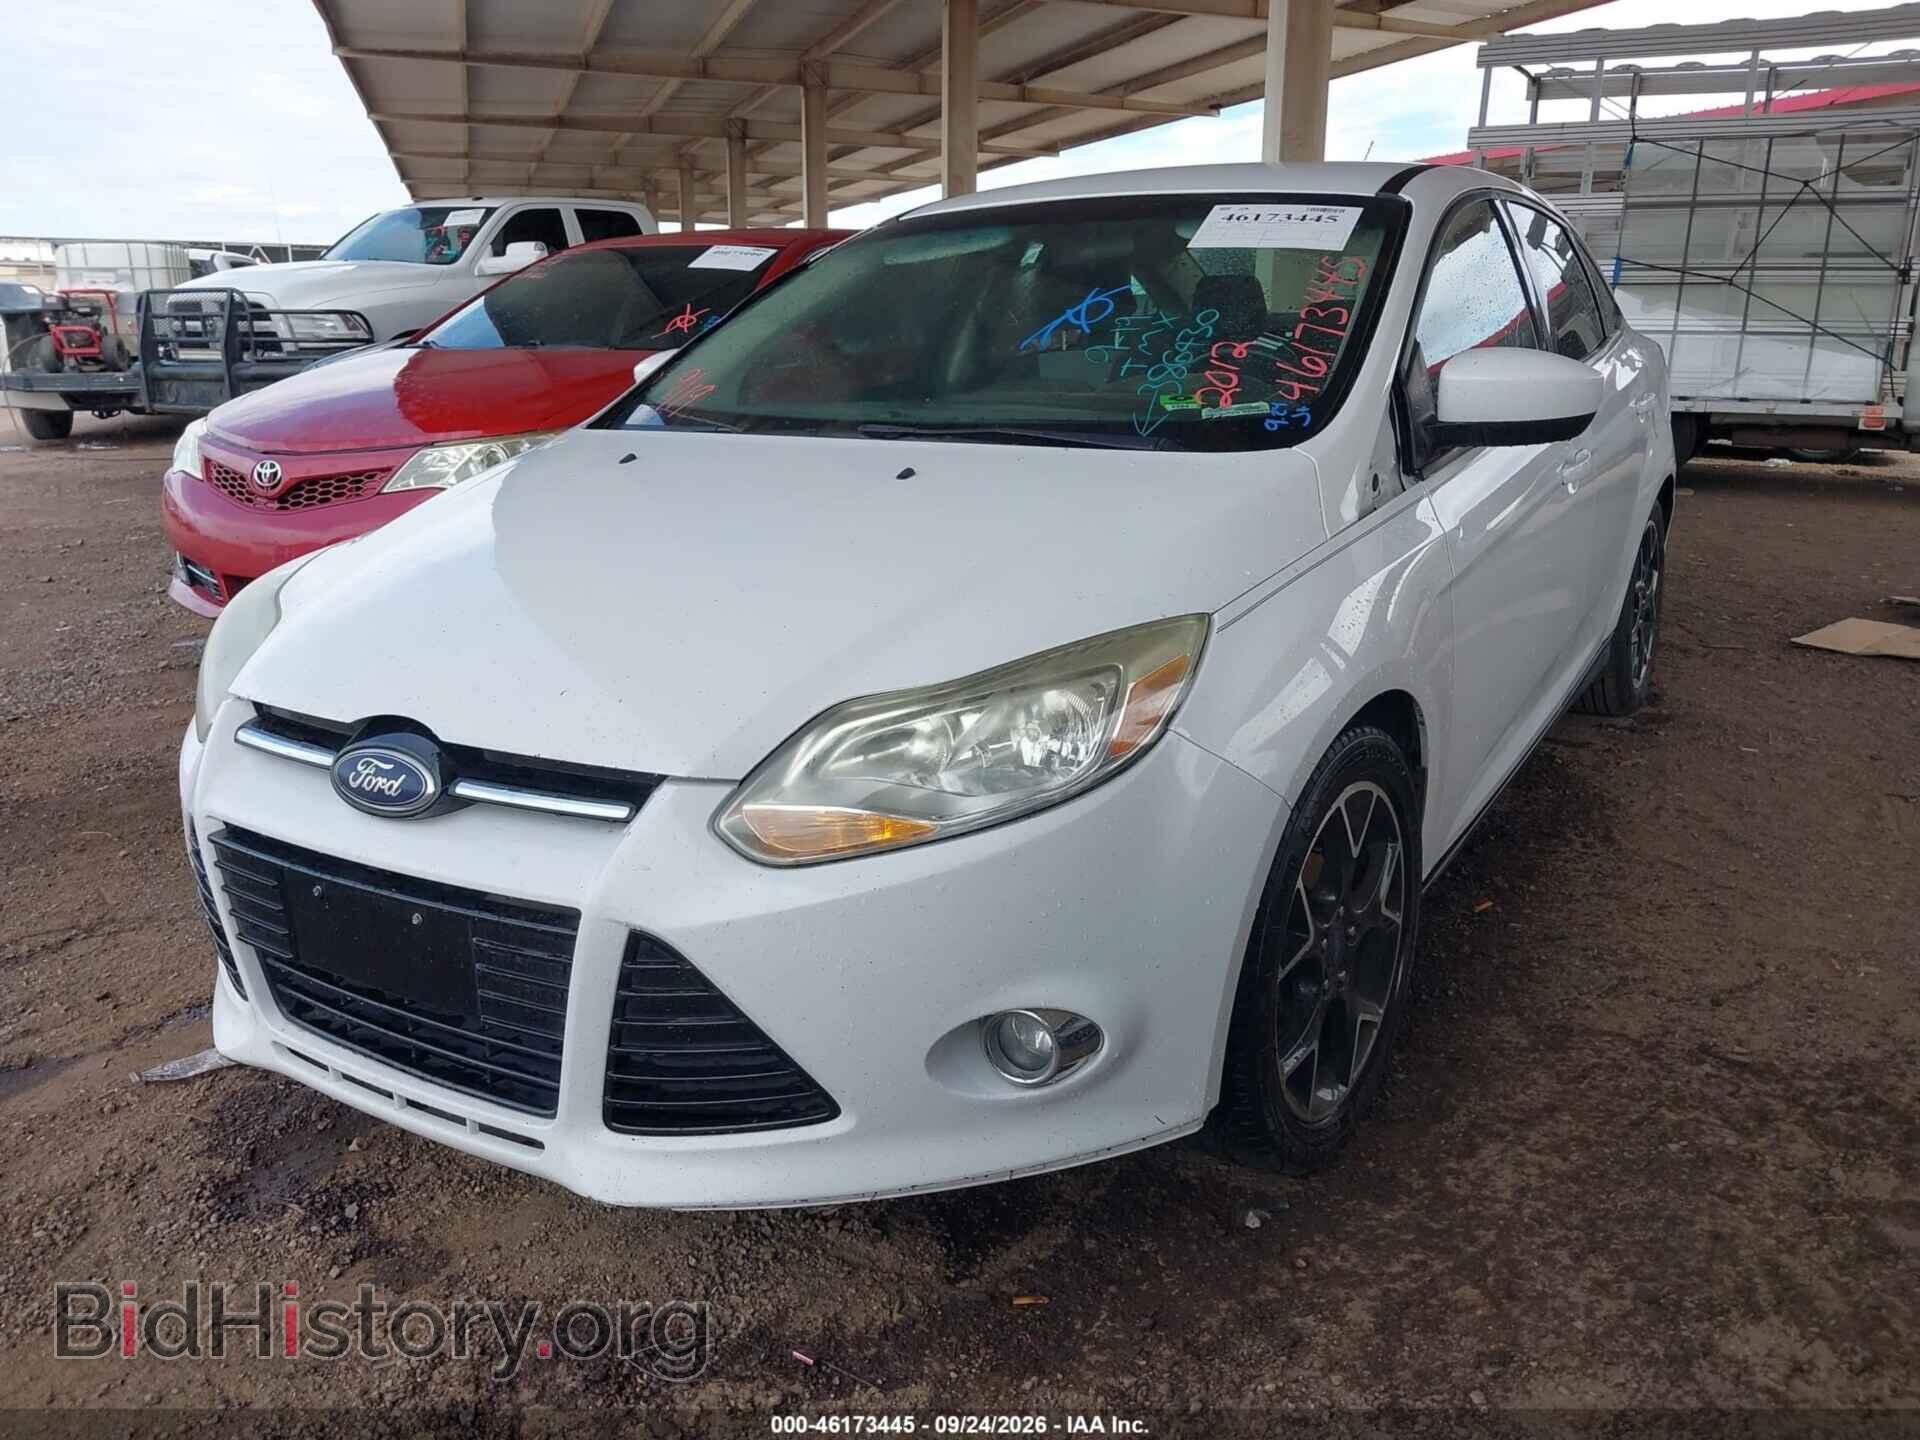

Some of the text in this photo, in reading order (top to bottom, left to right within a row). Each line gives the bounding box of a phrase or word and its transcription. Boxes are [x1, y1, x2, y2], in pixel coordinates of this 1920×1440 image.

[1221, 213, 1340, 223] 46173445
[1275, 256, 1367, 400] 46173445
[1195, 341, 1256, 409] 2012
[348, 757, 407, 797] Ford
